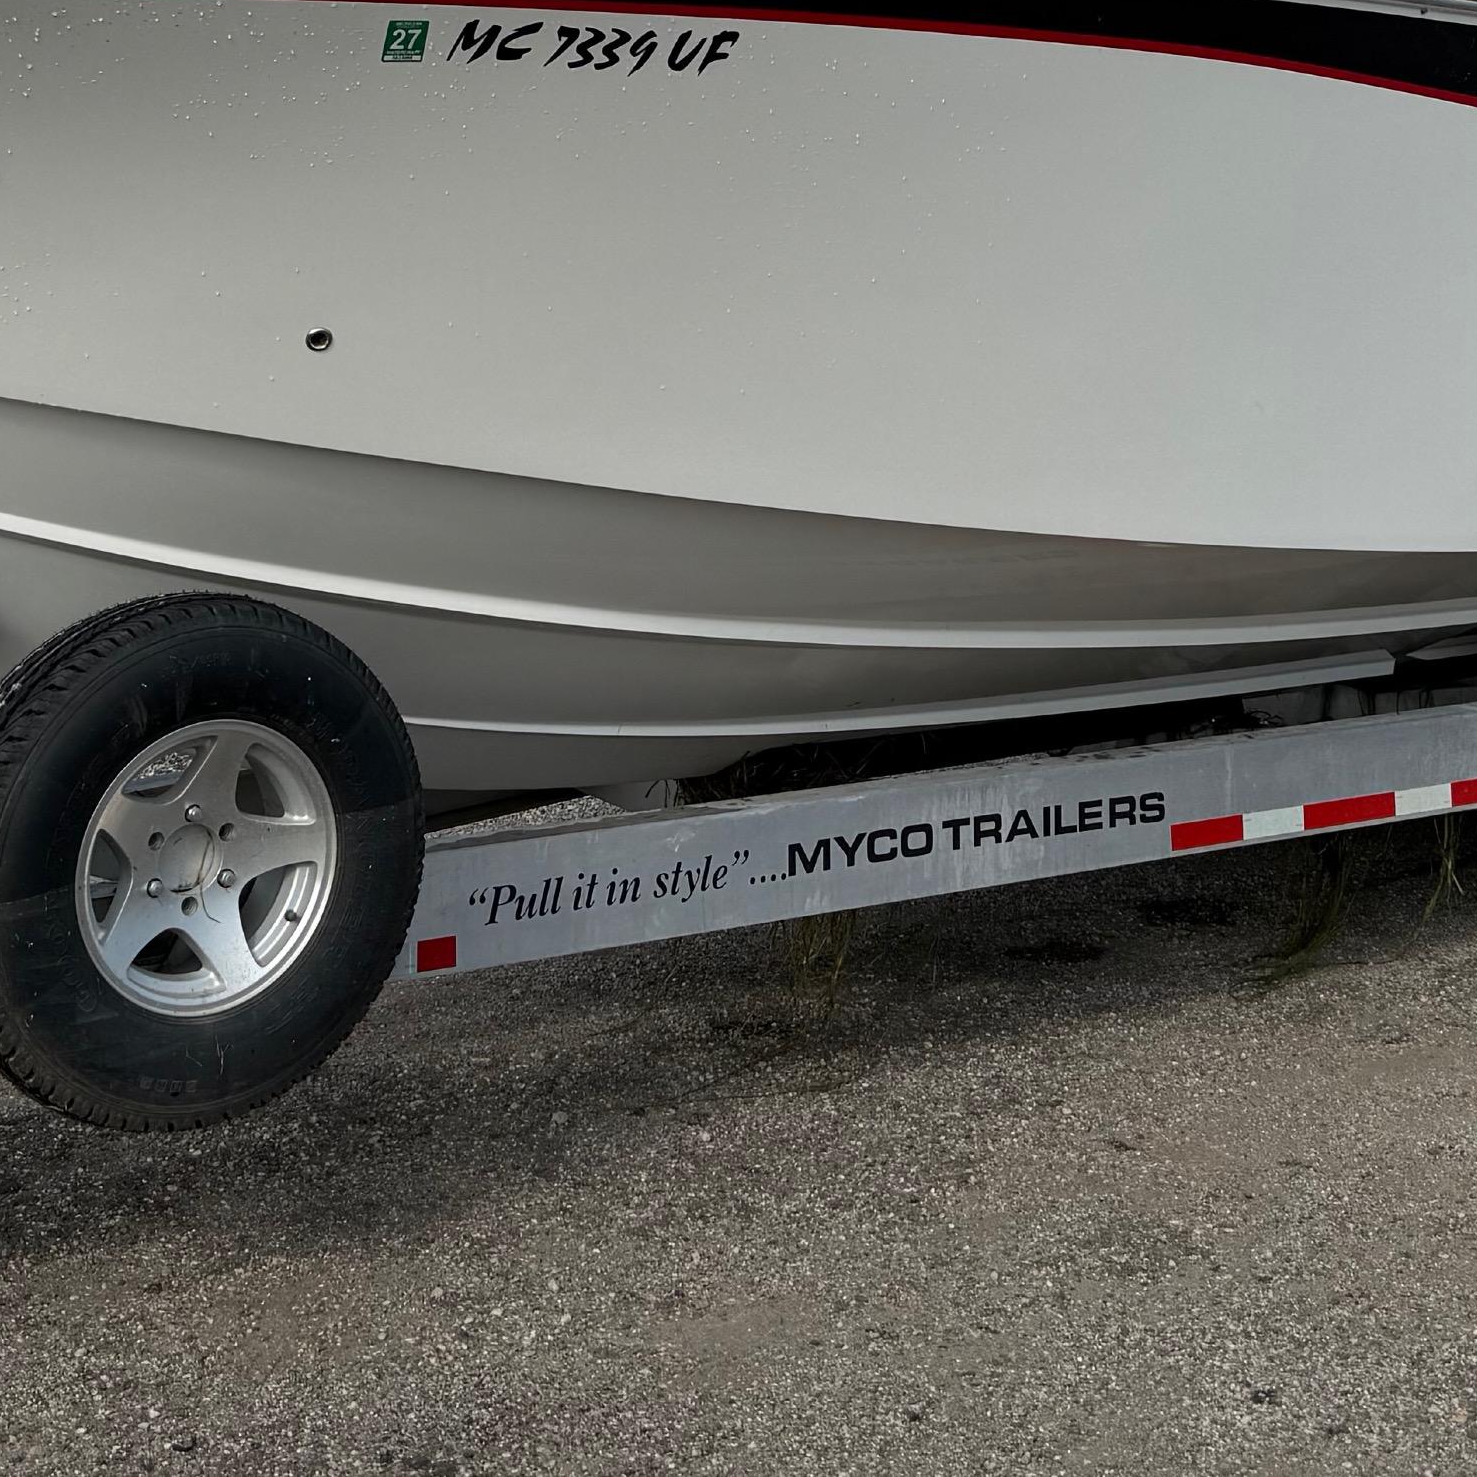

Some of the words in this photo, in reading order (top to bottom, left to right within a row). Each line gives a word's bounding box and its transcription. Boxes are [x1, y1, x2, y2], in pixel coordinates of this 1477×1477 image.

[390, 29, 422, 49] 27
[446, 19, 544, 64] MC
[543, 26, 658, 77] 7339
[667, 30, 740, 77] UF
[572, 873, 598, 911] it
[607, 867, 641, 906] in
[942, 792, 1165, 851] TRAILERS
